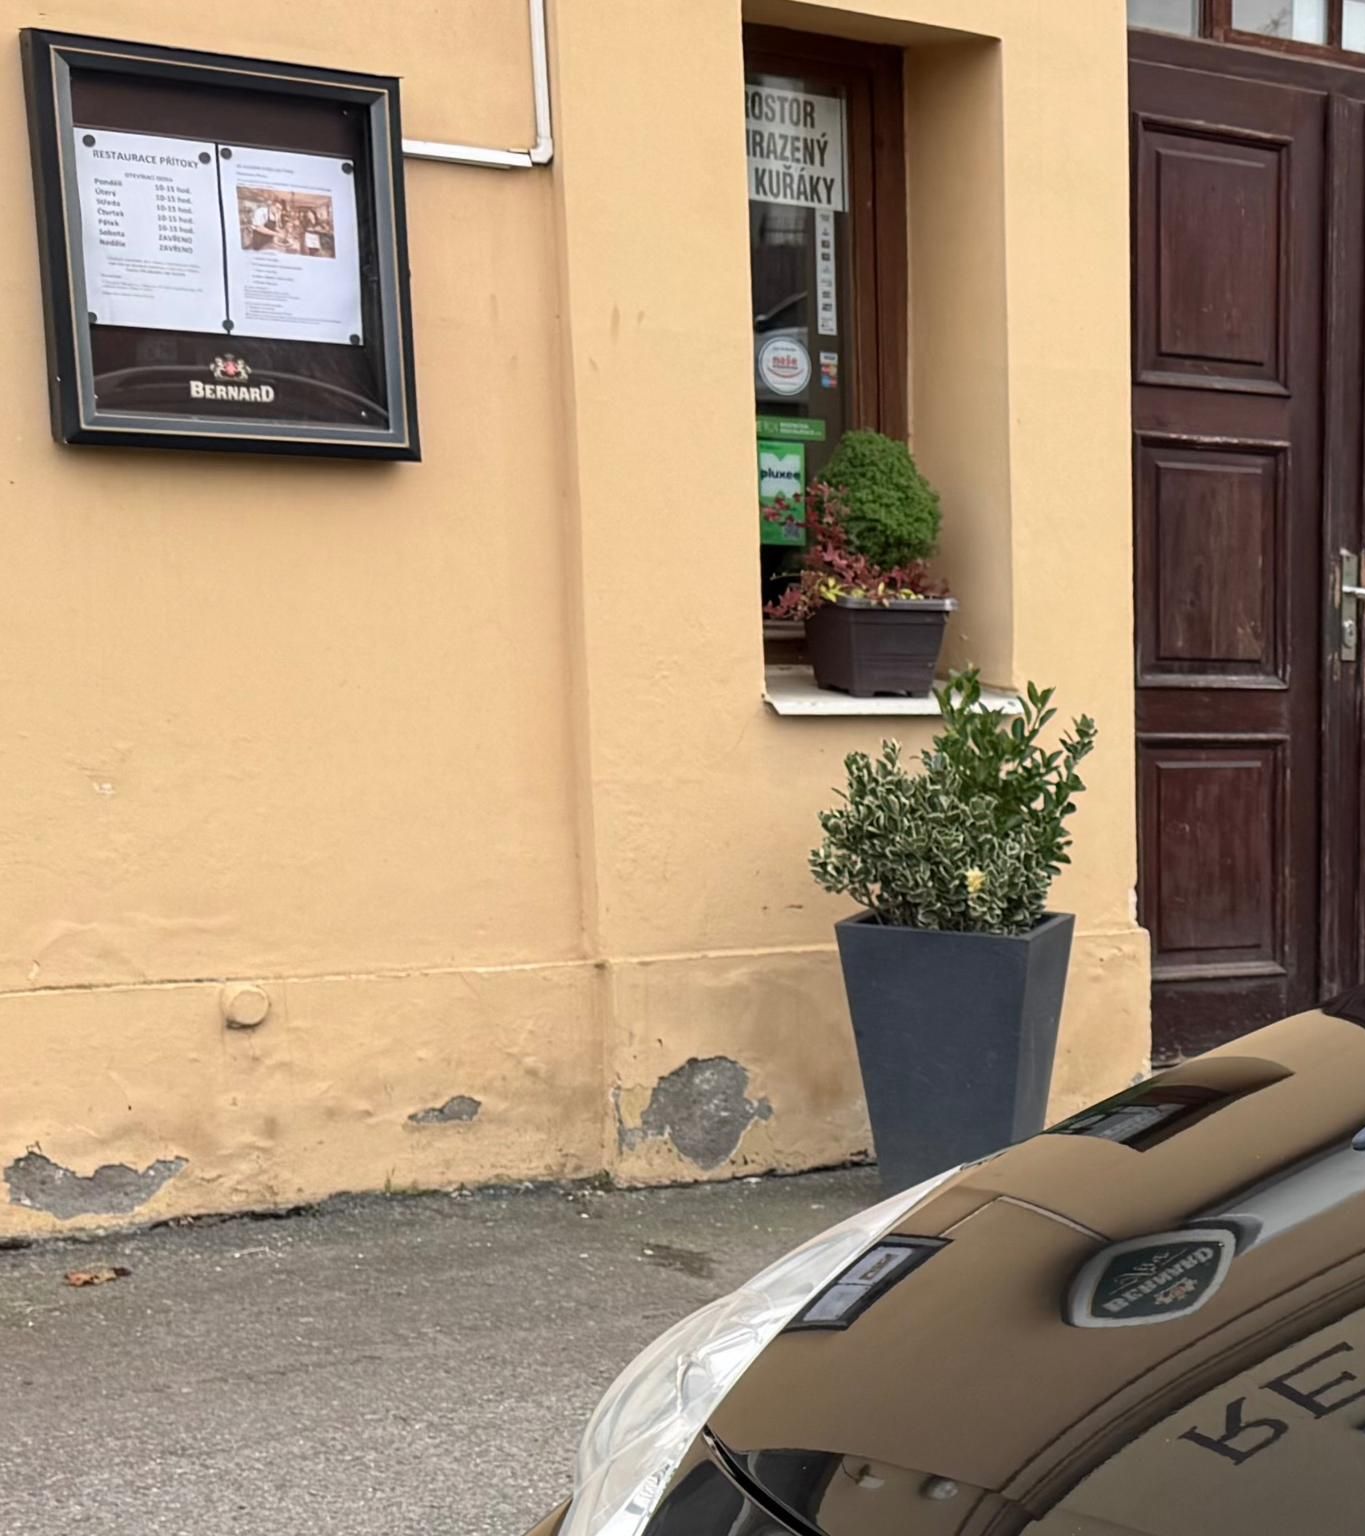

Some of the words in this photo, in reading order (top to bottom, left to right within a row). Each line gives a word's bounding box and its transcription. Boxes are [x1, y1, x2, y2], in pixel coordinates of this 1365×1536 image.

[93, 149, 156, 164] RESTAURACE
[159, 155, 198, 168] PŘÍTOKY
[754, 163, 835, 206] KUŘÁKY
[189, 380, 275, 403] BERNARD
[760, 467, 801, 480] pluxee
